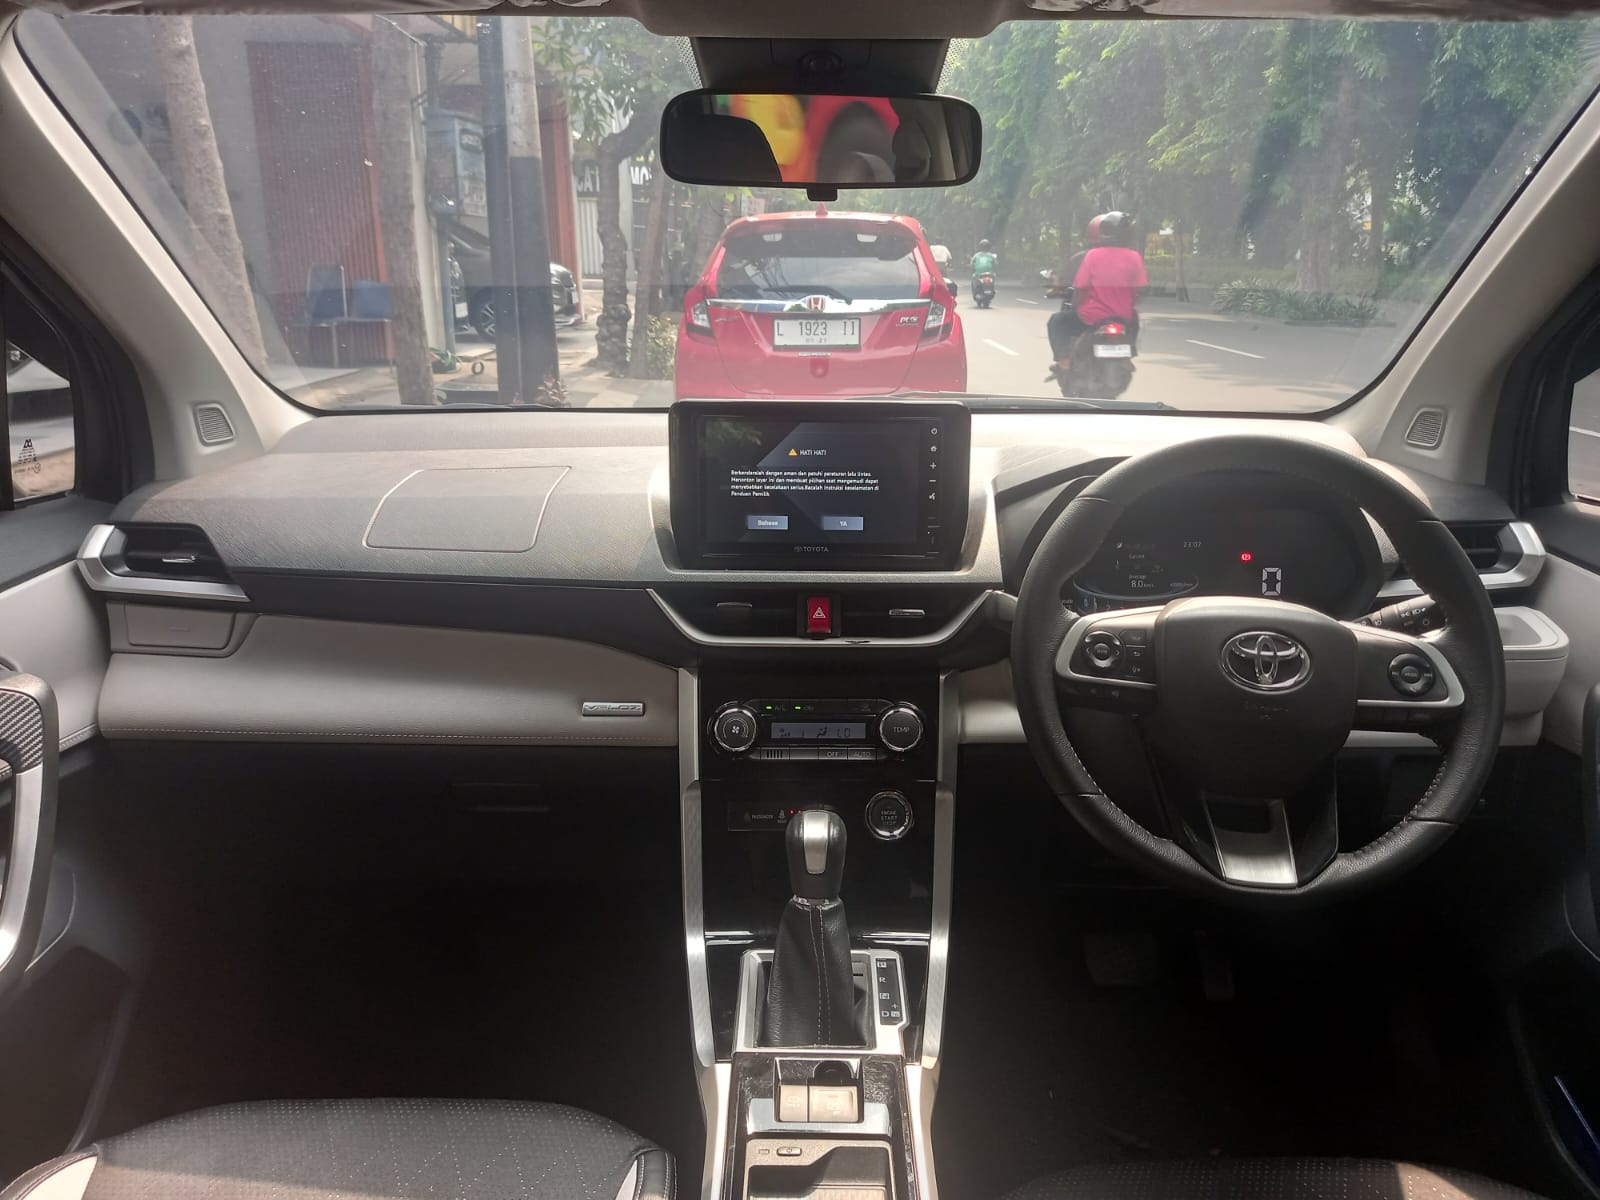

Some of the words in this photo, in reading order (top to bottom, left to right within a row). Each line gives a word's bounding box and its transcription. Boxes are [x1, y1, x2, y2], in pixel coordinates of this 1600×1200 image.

[776, 322, 784, 336] L
[798, 321, 828, 336] 1923
[757, 519, 779, 527] Bahasa
[803, 545, 830, 553] TOYOTA
[1262, 567, 1282, 596] 0
[892, 726, 910, 734] TEMP
[881, 1010, 890, 1018] D
